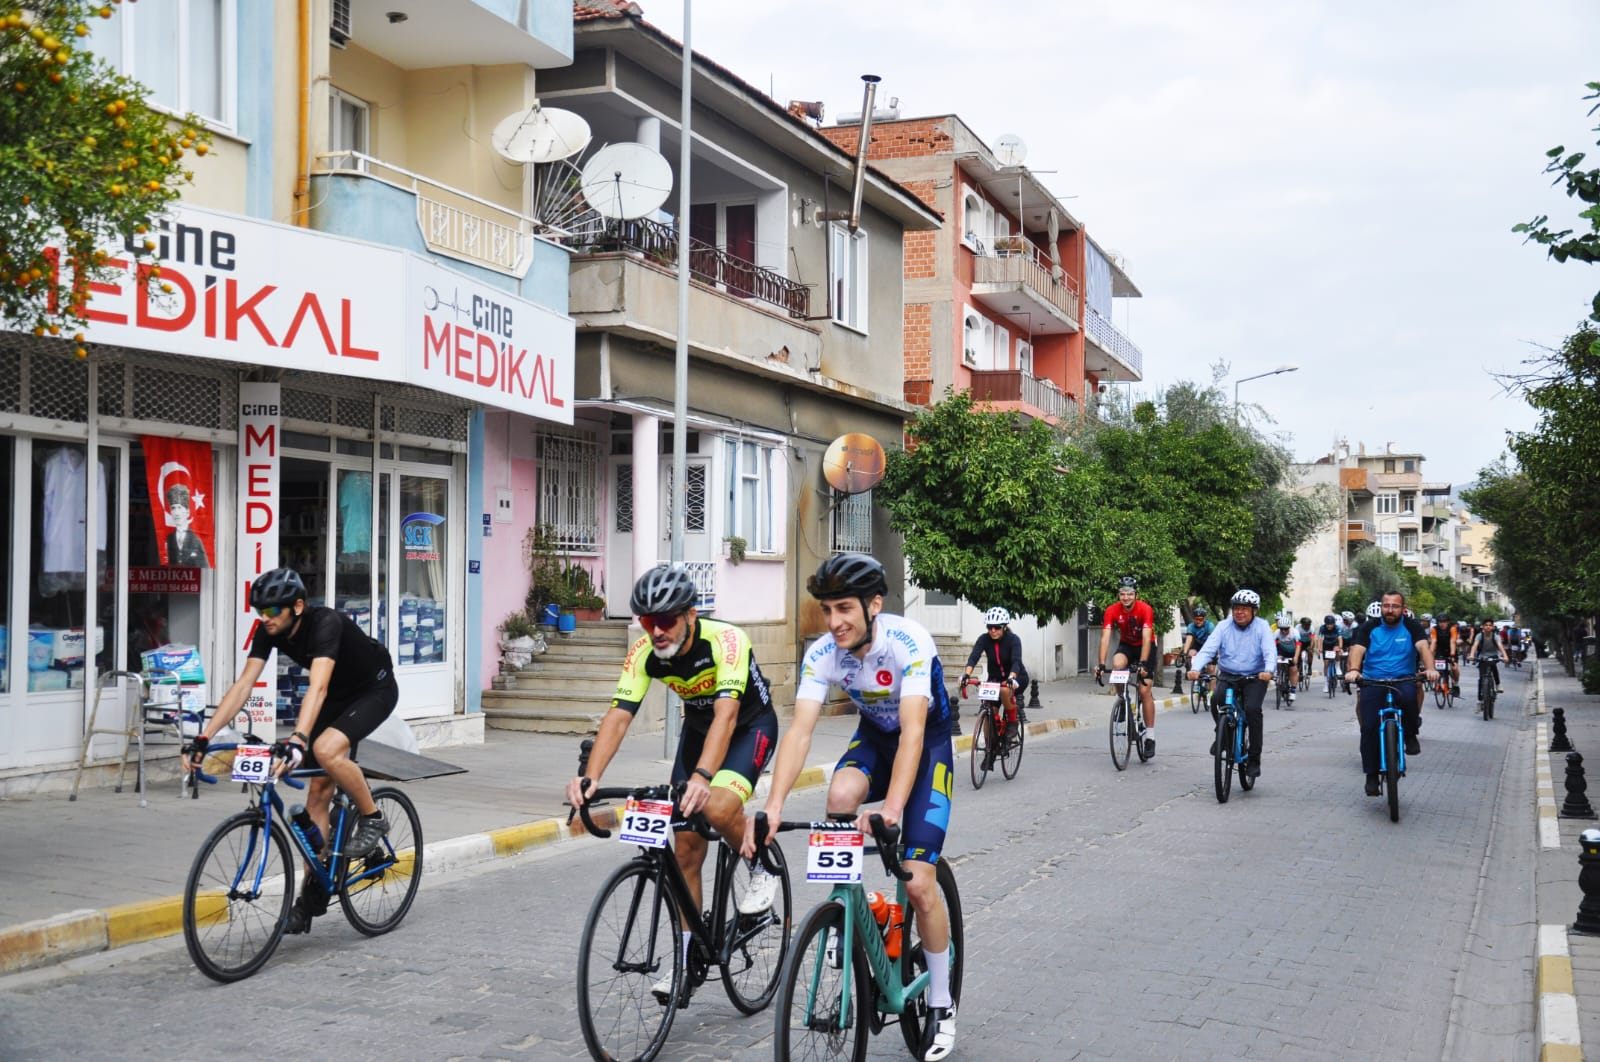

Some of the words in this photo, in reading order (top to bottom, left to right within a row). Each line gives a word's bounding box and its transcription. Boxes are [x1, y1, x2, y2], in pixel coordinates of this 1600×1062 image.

[423, 314, 565, 408] MEDİKAL
[404, 525, 433, 545] SGK
[243, 424, 276, 688] MEDİ
[139, 568, 196, 581] MEDİKAL
[240, 761, 263, 773] 68
[625, 815, 667, 835] 132
[817, 851, 854, 868] 53
